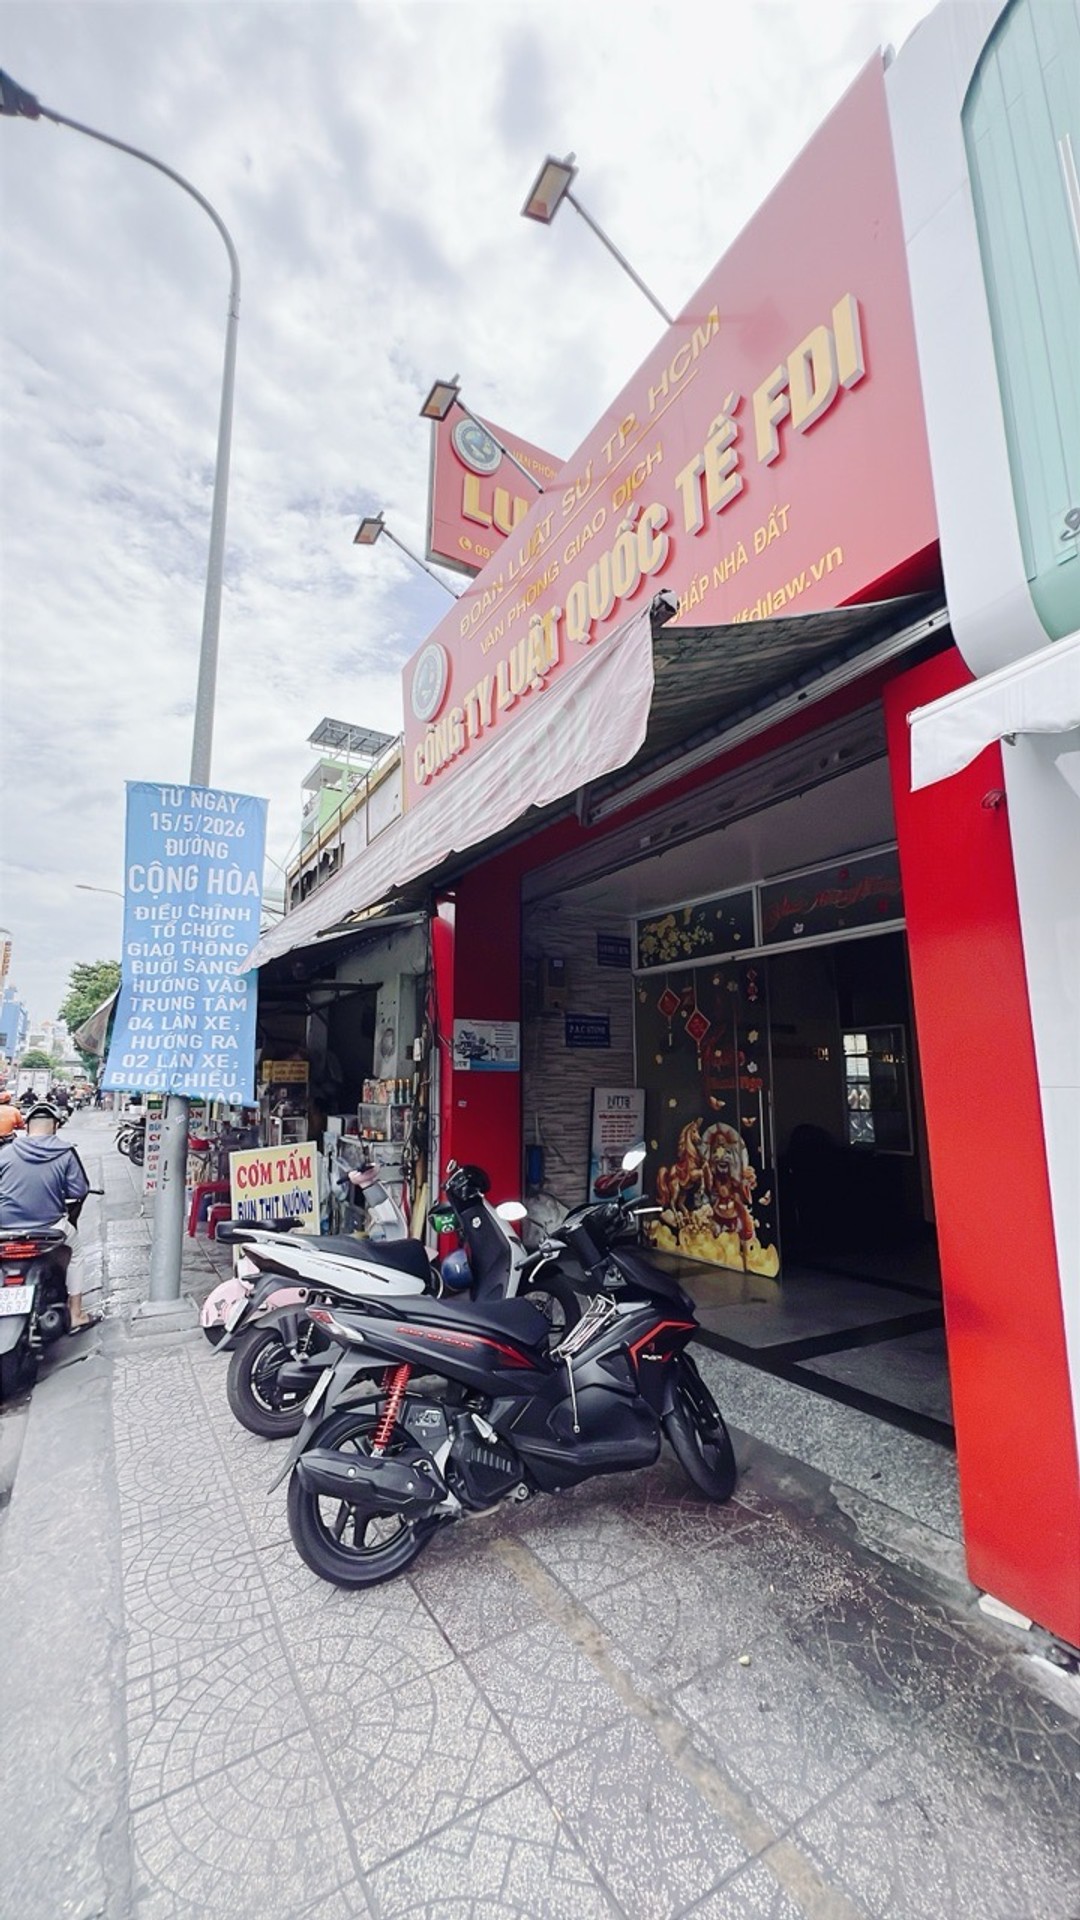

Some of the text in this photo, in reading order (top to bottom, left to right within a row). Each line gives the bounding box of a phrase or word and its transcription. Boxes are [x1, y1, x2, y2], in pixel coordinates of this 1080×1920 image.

[562, 459, 593, 516] SƯ
[648, 305, 720, 413] HCM
[462, 473, 529, 535] LU
[563, 507, 606, 564] GIAO
[612, 440, 663, 513] DỊCH
[414, 707, 465, 786] CÔNG
[464, 672, 495, 739] TY
[496, 605, 562, 711] LUẬT
[565, 502, 670, 644] QUỐC
[675, 390, 743, 536] TẾ
[752, 292, 866, 467] FDI
[671, 504, 791, 623] HẤP NHÀ ĐẤT
[191, 790, 240, 814] NGÀY
[150, 812, 246, 838] 15/5/2026
[164, 834, 229, 859] ĐƯỜNG
[128, 861, 260, 899] CỘNG HÒA
[181, 921, 236, 939] CHỨC
[127, 940, 249, 957] GIAO THÔNG
[131, 956, 241, 975] BUỔI SÁNG
[132, 975, 247, 993] HƯỚNG VÀO
[129, 994, 247, 1012] TRUNG TÂM
[127, 1017, 154, 1031] 04
[161, 1012, 197, 1031] LÀN
[130, 1032, 238, 1050] HƯỚNG RA
[121, 1054, 149, 1068] 02
[156, 1050, 193, 1068] LÀN
[110, 1068, 166, 1087] BUỔI
[236, 1149, 312, 1189] CƠM TẤM
[238, 1194, 257, 1220] BÚN
[281, 1185, 313, 1216] NƯỚNG
